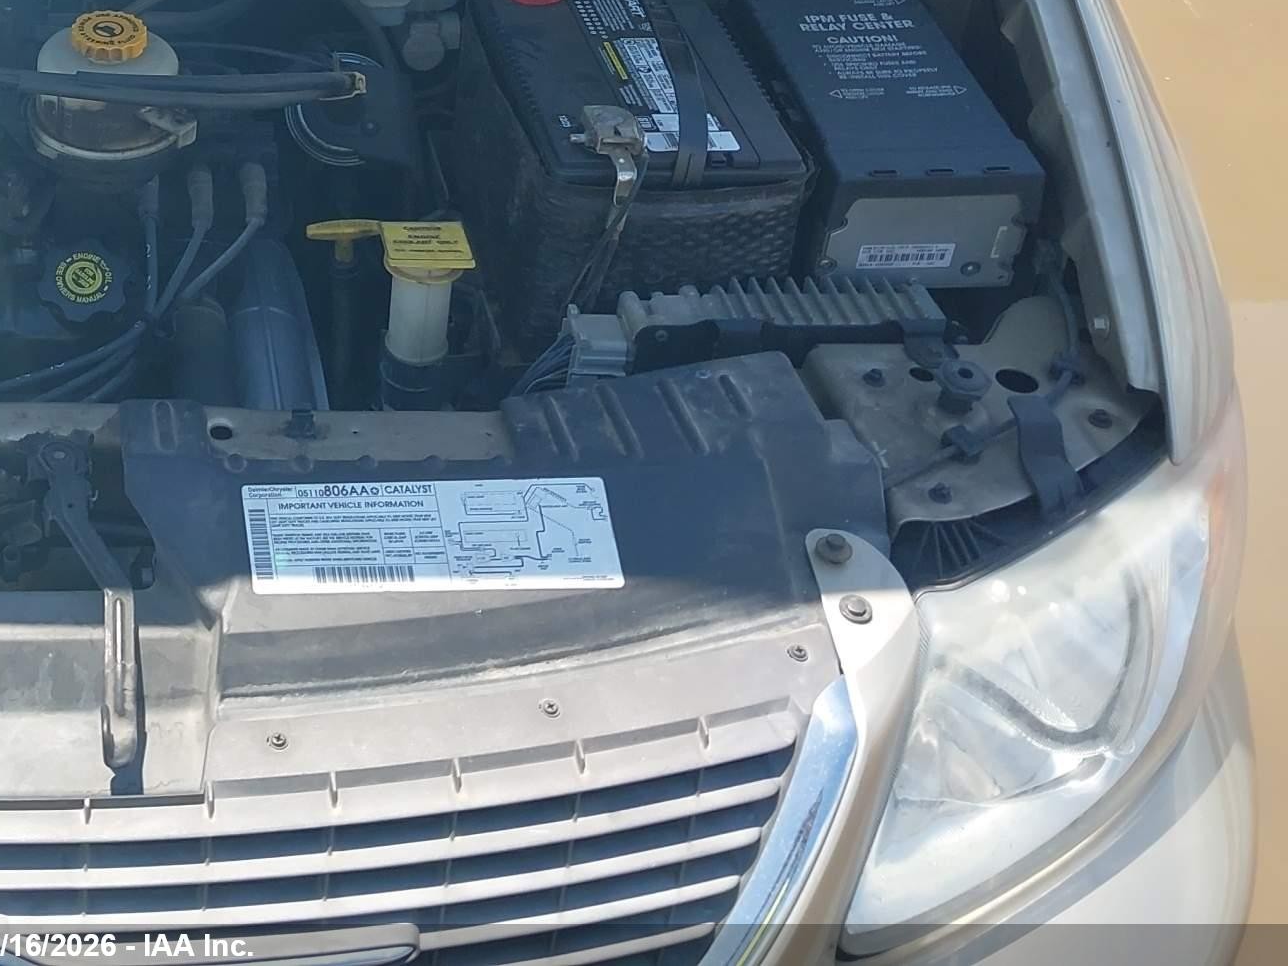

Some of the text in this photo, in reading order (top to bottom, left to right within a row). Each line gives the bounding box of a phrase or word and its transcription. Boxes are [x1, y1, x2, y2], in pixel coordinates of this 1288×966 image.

[804, 12, 895, 24] IPM FUSE &
[799, 19, 916, 32] RELAY CENTER
[826, 34, 899, 45] CAUTION!
[72, 252, 101, 263] ENGINE
[104, 271, 113, 284] OIL
[75, 292, 106, 304] MANUAL
[384, 484, 432, 495] CATALYST
[328, 501, 362, 510] VEHICLE
[364, 499, 424, 509] INFORMATION
